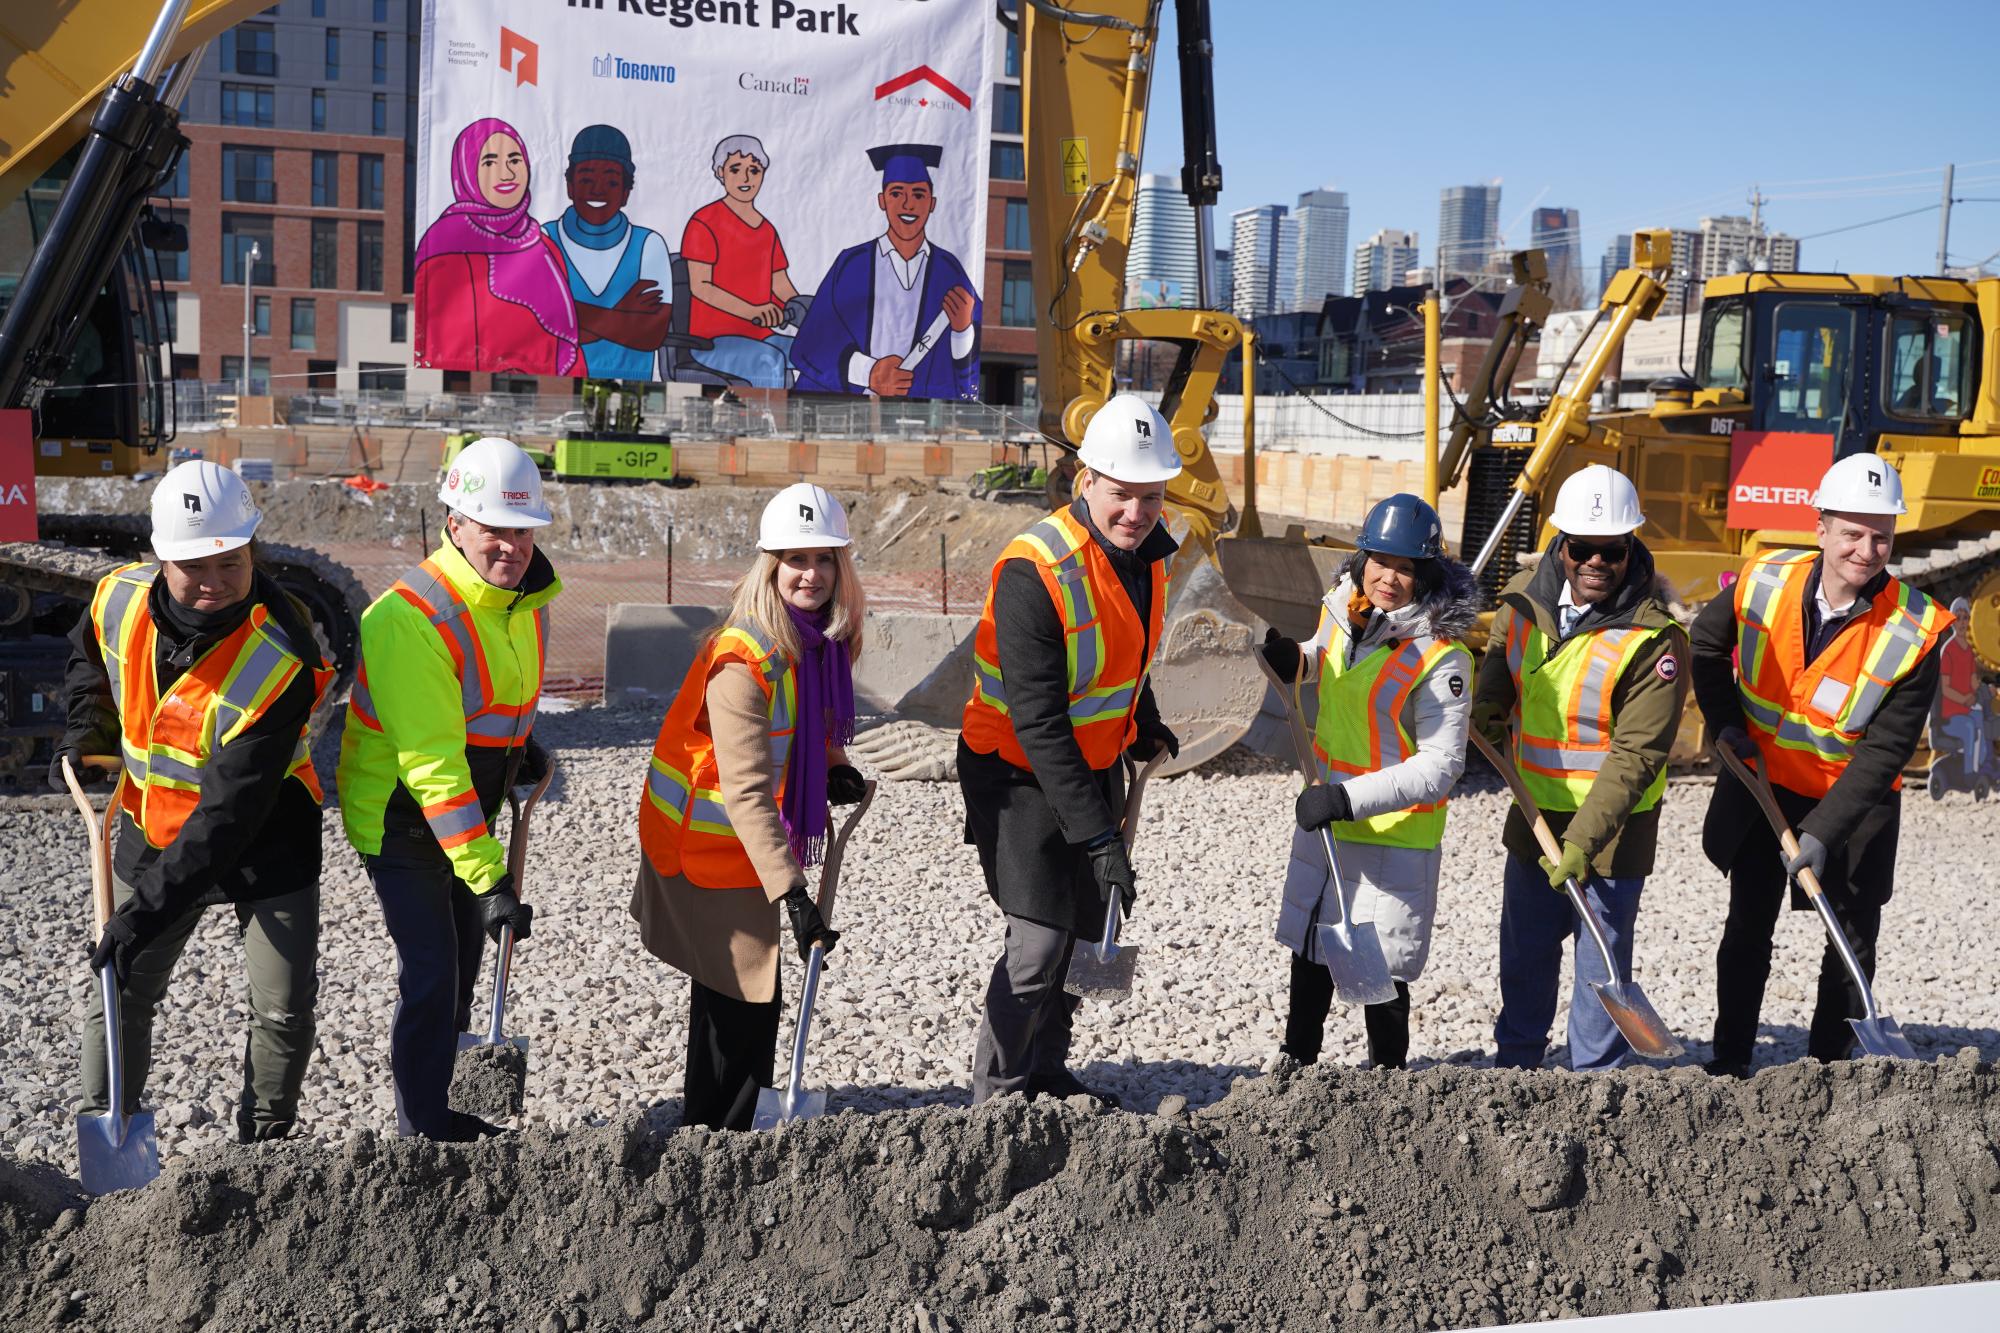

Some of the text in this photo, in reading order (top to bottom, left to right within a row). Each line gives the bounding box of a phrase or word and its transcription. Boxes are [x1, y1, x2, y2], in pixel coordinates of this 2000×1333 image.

[771, 0, 860, 36] Park
[448, 40, 475, 48] Toronto
[448, 49, 488, 60] Community
[448, 58, 478, 67] Housing
[614, 57, 676, 84] TORONTO
[738, 72, 808, 95] Canada
[888, 96, 917, 107] CMHC
[1711, 417, 1735, 435] D6T
[1982, 468, 2000, 485] CO
[0, 484, 28, 505] A
[501, 491, 531, 500] TRIDEL
